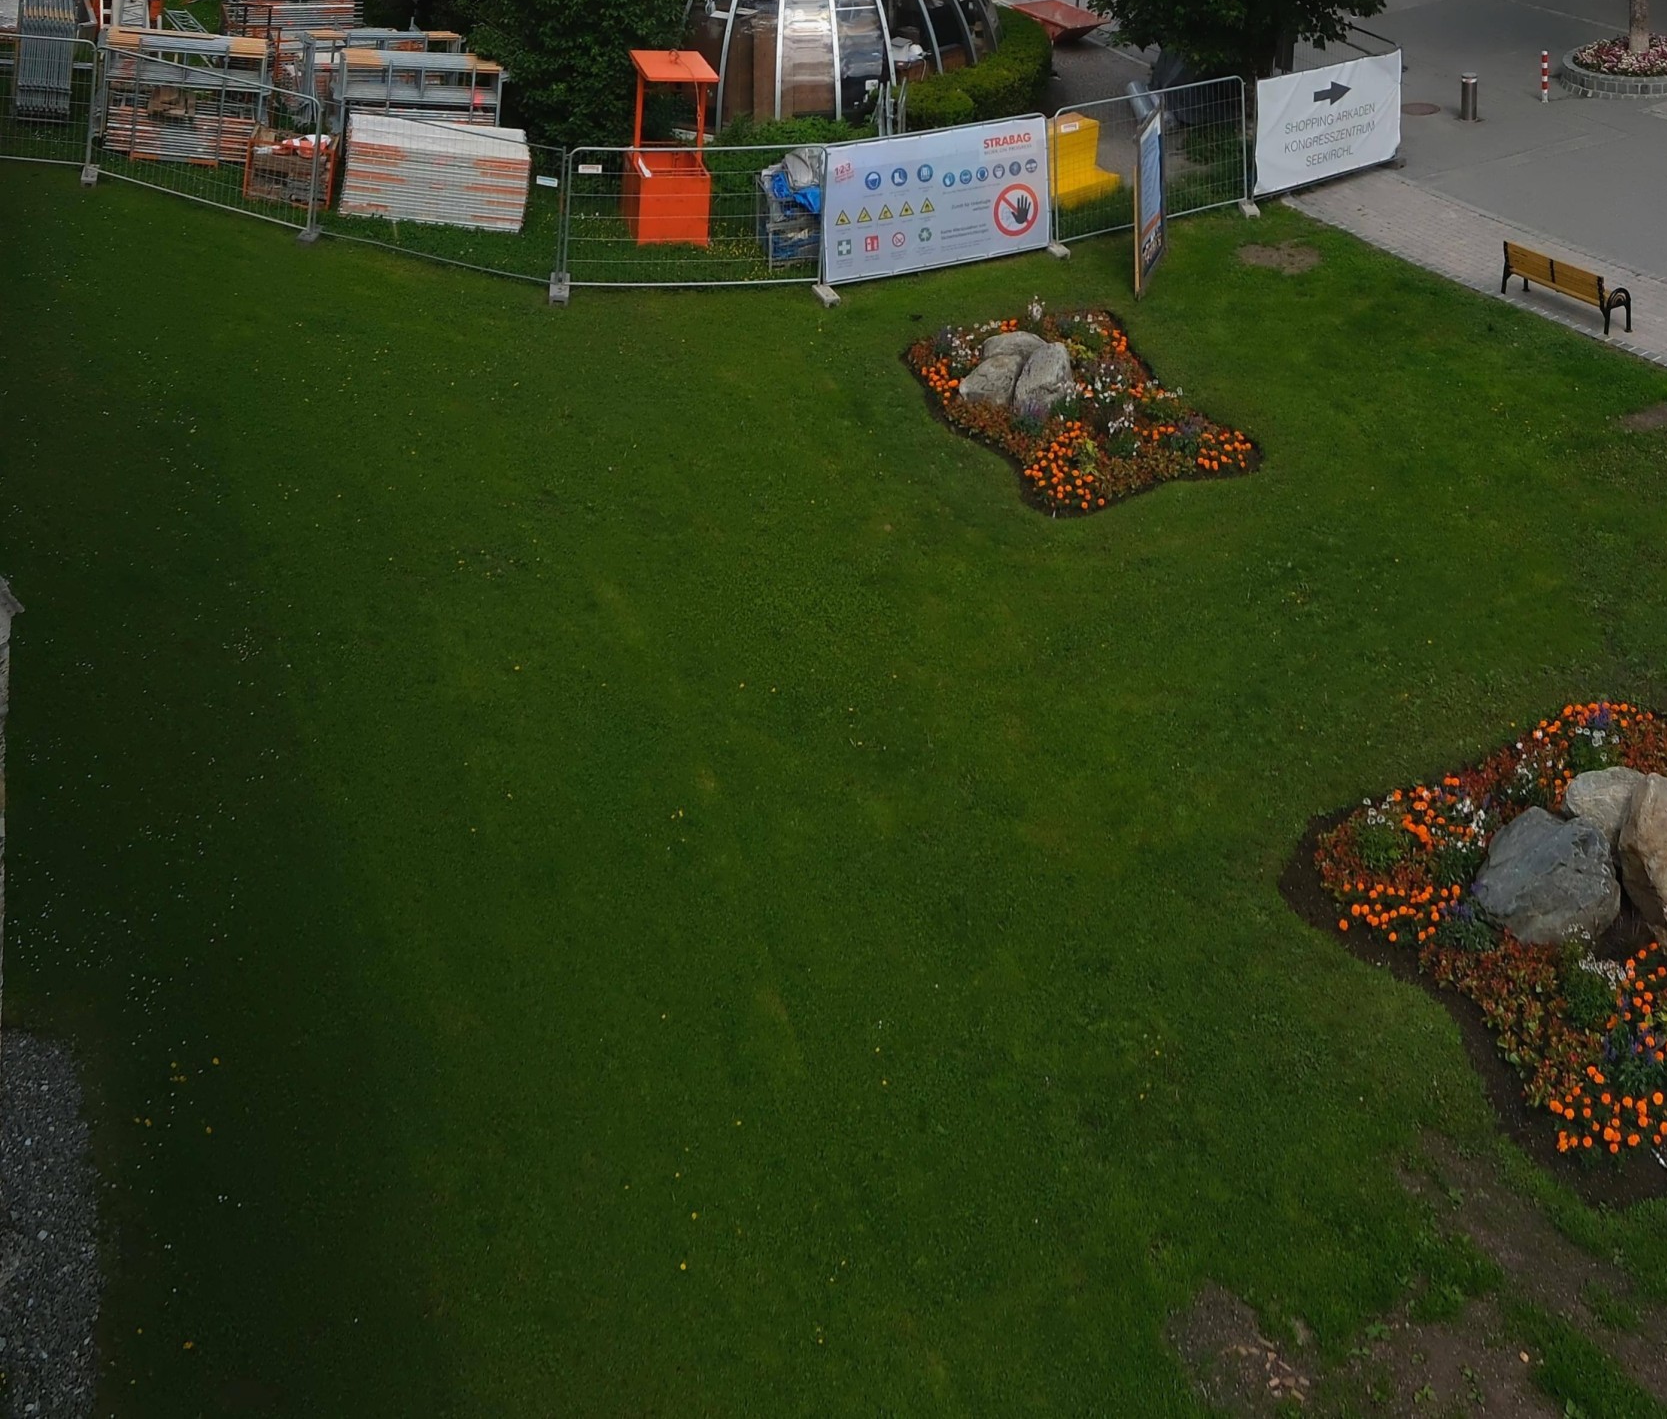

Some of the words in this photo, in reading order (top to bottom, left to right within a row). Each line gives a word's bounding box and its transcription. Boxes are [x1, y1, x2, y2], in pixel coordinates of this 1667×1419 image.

[1284, 113, 1334, 135] SHOPPING
[1336, 103, 1375, 122] ARKADEN
[983, 133, 1031, 149] STRABAG
[1284, 121, 1376, 154] KONGRESSZENTRUM
[1305, 145, 1354, 167] SEEKIRCHL
